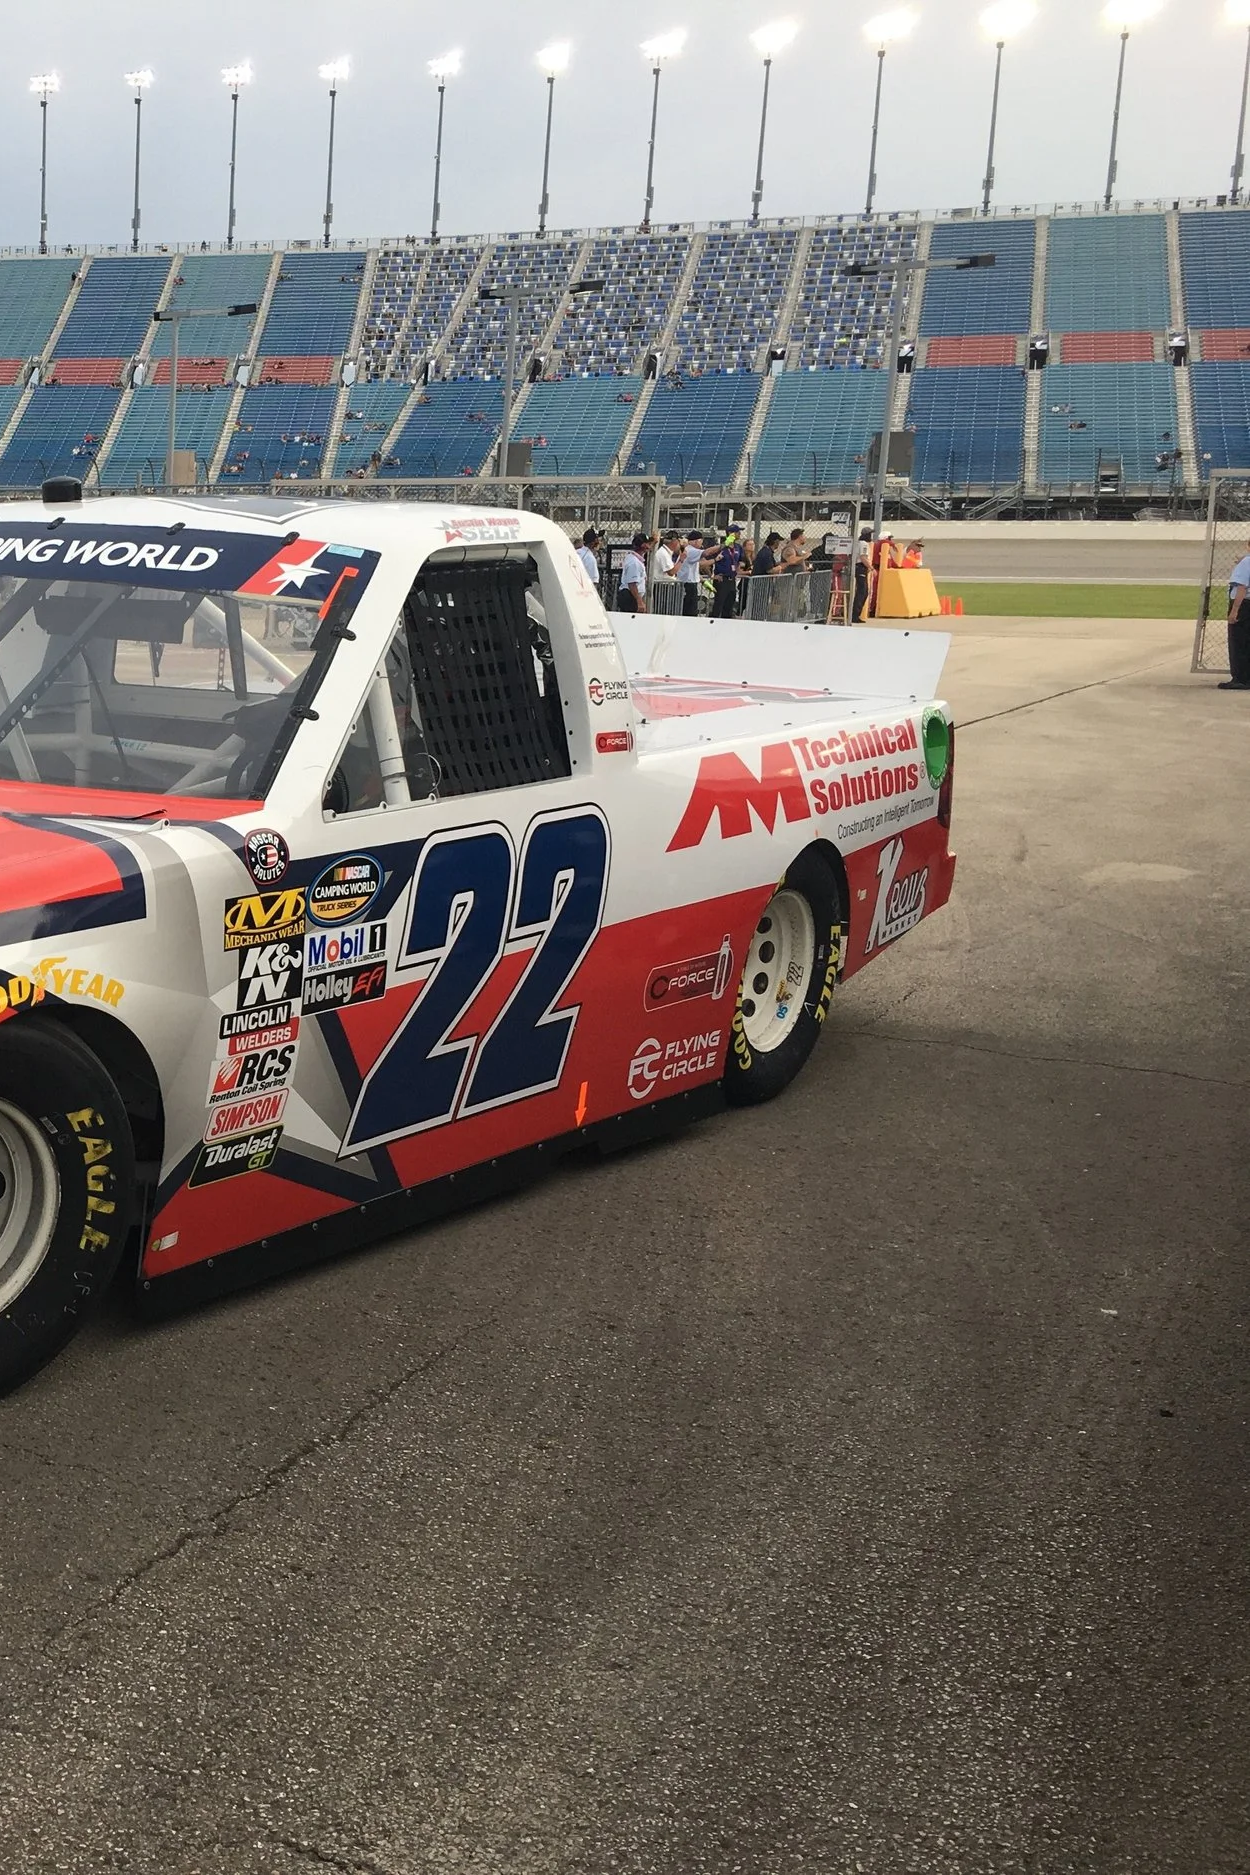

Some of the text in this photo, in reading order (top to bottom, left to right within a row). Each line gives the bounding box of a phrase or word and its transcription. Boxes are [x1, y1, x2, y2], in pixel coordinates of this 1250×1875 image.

[461, 527, 520, 541] SELF
[64, 541, 219, 572] WORLD
[604, 681, 627, 690] FLYING
[606, 692, 628, 700] CIRCLE
[792, 717, 918, 772] Technical
[810, 762, 919, 815] Solutions
[837, 814, 875, 839] Constructing
[876, 813, 883, 827] an
[884, 803, 910, 822] Intelligent
[249, 833, 279, 852] NASCAR
[253, 860, 285, 880] SALUTES
[344, 865, 371, 880] NASCAR
[315, 881, 376, 899] CAMPING WORLD
[316, 900, 358, 913] TRUCK SERIES
[224, 920, 305, 950] MECHANIX WEAR
[881, 913, 918, 940] MARKET
[308, 927, 365, 966] Mobil
[307, 963, 327, 974] OFFICIAL
[328, 960, 345, 970] MOTOR
[358, 951, 386, 963] LUBRICANTS
[814, 925, 842, 1024] EAGLE
[303, 974, 354, 1006] Holley
[337, 802, 612, 1162] 22
[223, 1005, 288, 1037] LINCOLN
[236, 1026, 291, 1052] WELDERS
[664, 1029, 722, 1060] FLYING
[236, 1045, 295, 1088] RCS
[662, 1051, 718, 1081] CIRCLE
[209, 1077, 287, 1105] Renton Coil Spring
[211, 1094, 283, 1136] SIMPSON
[204, 1128, 278, 1168] Duralast
[247, 1150, 273, 1169] GT
[65, 1106, 117, 1253] EAGLE
